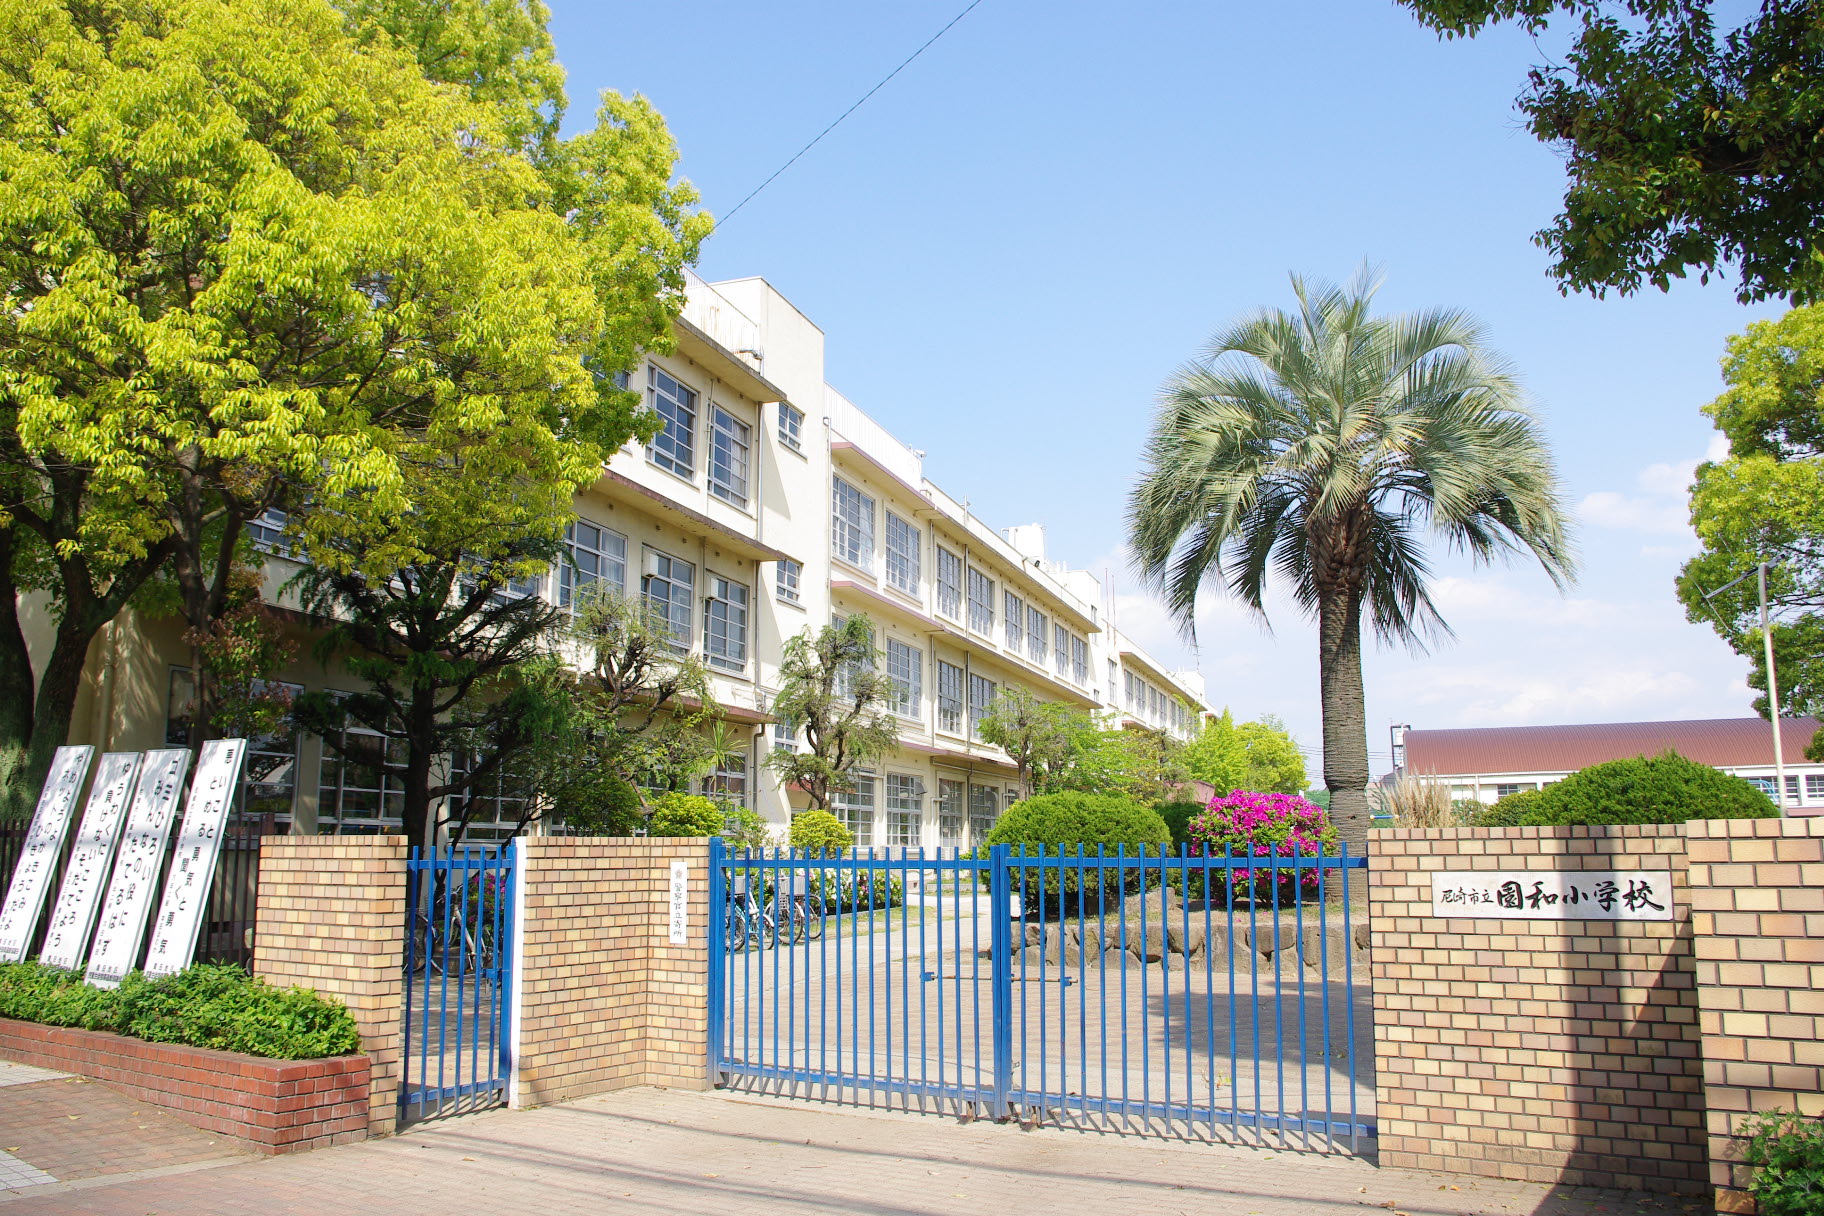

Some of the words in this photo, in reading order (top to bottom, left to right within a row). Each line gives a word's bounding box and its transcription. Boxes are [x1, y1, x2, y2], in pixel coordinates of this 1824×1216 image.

[19, 770, 70, 909] ネットのかきこみ
[49, 752, 84, 841] やめようよ
[98, 761, 132, 856] ゆうわくに
[142, 758, 181, 881] ゴミひろい
[179, 779, 217, 912] とめる勇気と
[206, 749, 234, 839] 悪いこと
[4, 824, 44, 931] ひきょうだよ
[54, 854, 87, 948] そだてよう
[69, 790, 114, 925] 負けないこころ
[102, 836, 138, 956] たてるはず
[119, 778, 165, 927] みんなの役に
[673, 883, 683, 937] 警察官立寄所
